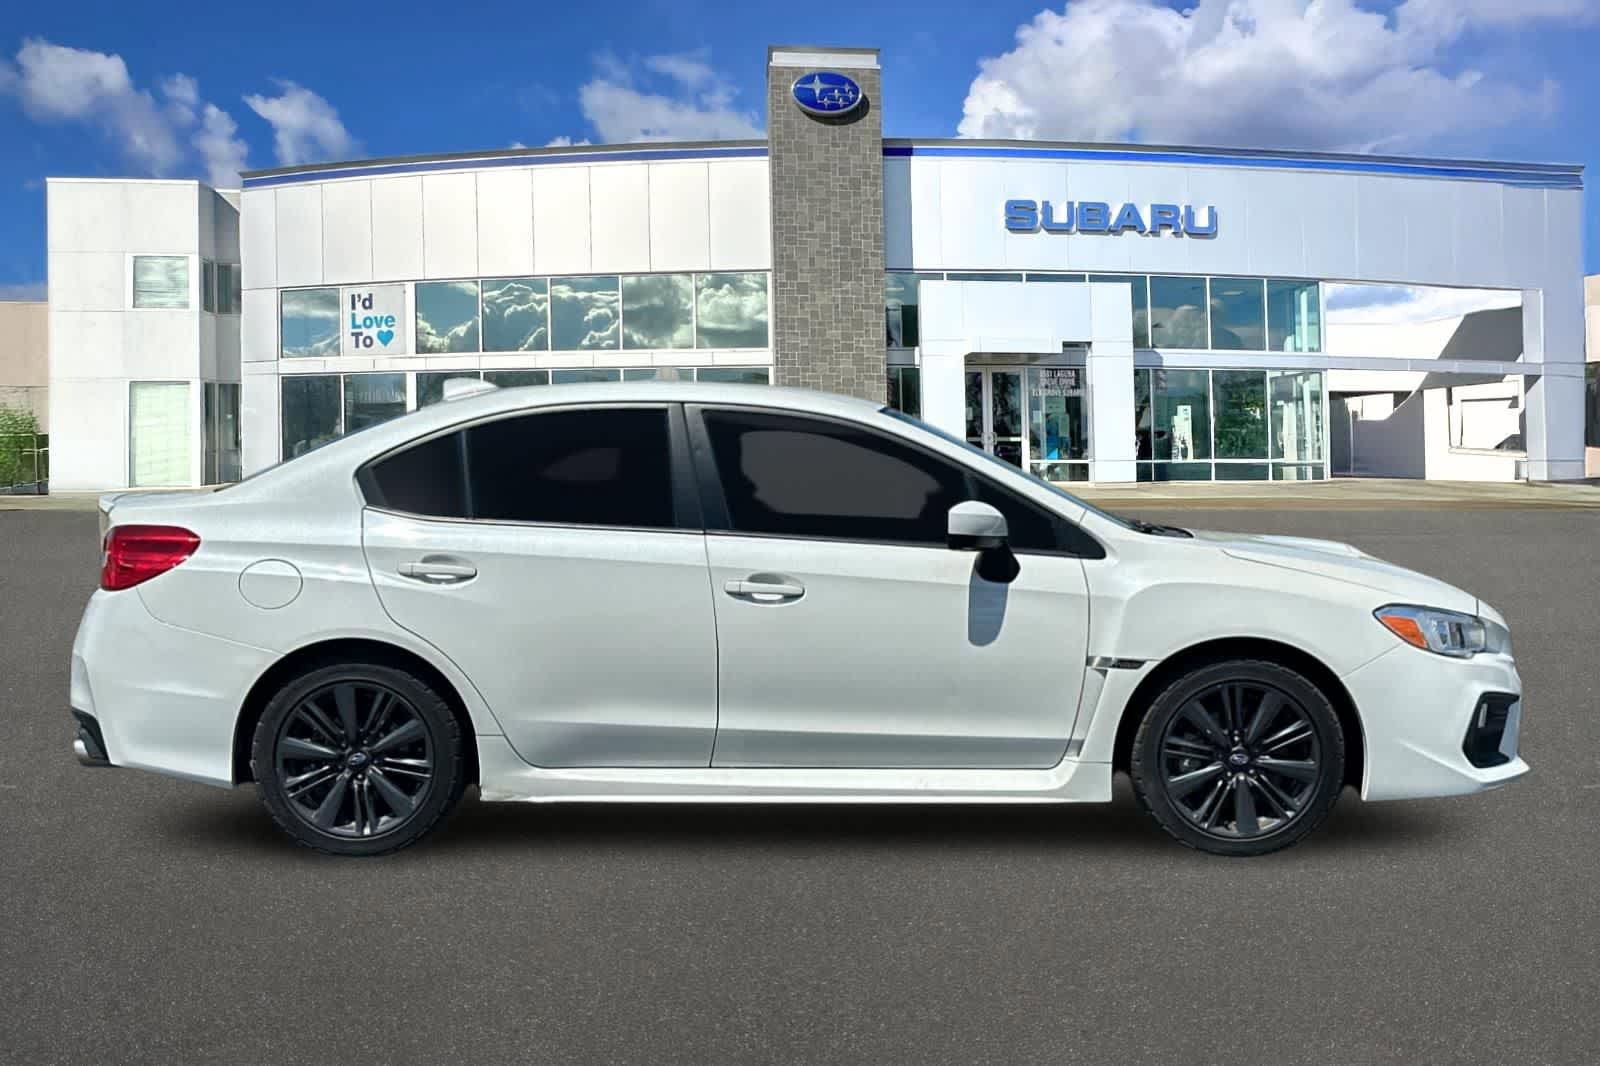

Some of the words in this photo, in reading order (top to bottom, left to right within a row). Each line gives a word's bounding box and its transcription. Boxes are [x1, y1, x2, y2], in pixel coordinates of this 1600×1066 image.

[1004, 199, 1218, 238] SUBARU
[351, 293, 373, 310] I'd
[351, 313, 396, 330] Love
[351, 332, 374, 349] To
